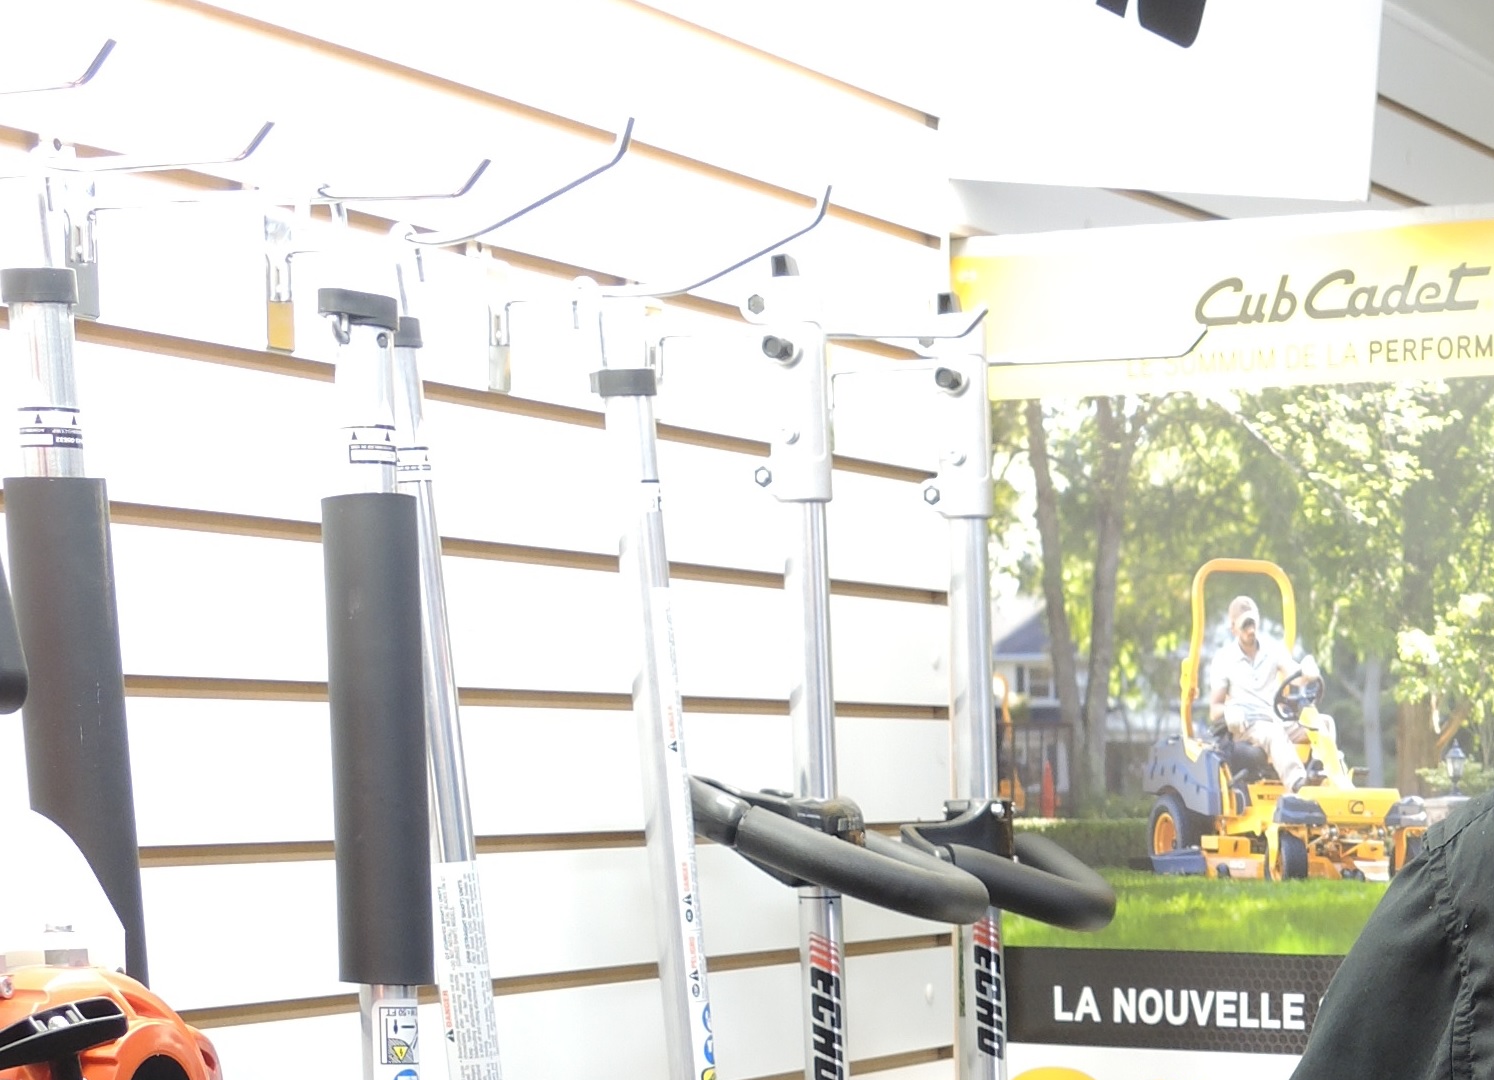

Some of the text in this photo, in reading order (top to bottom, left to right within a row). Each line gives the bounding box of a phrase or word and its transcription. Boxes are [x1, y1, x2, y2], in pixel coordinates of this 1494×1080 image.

[1194, 262, 1492, 327] Cub Cadet
[1053, 984, 1306, 1031] LA NOUVELLE
